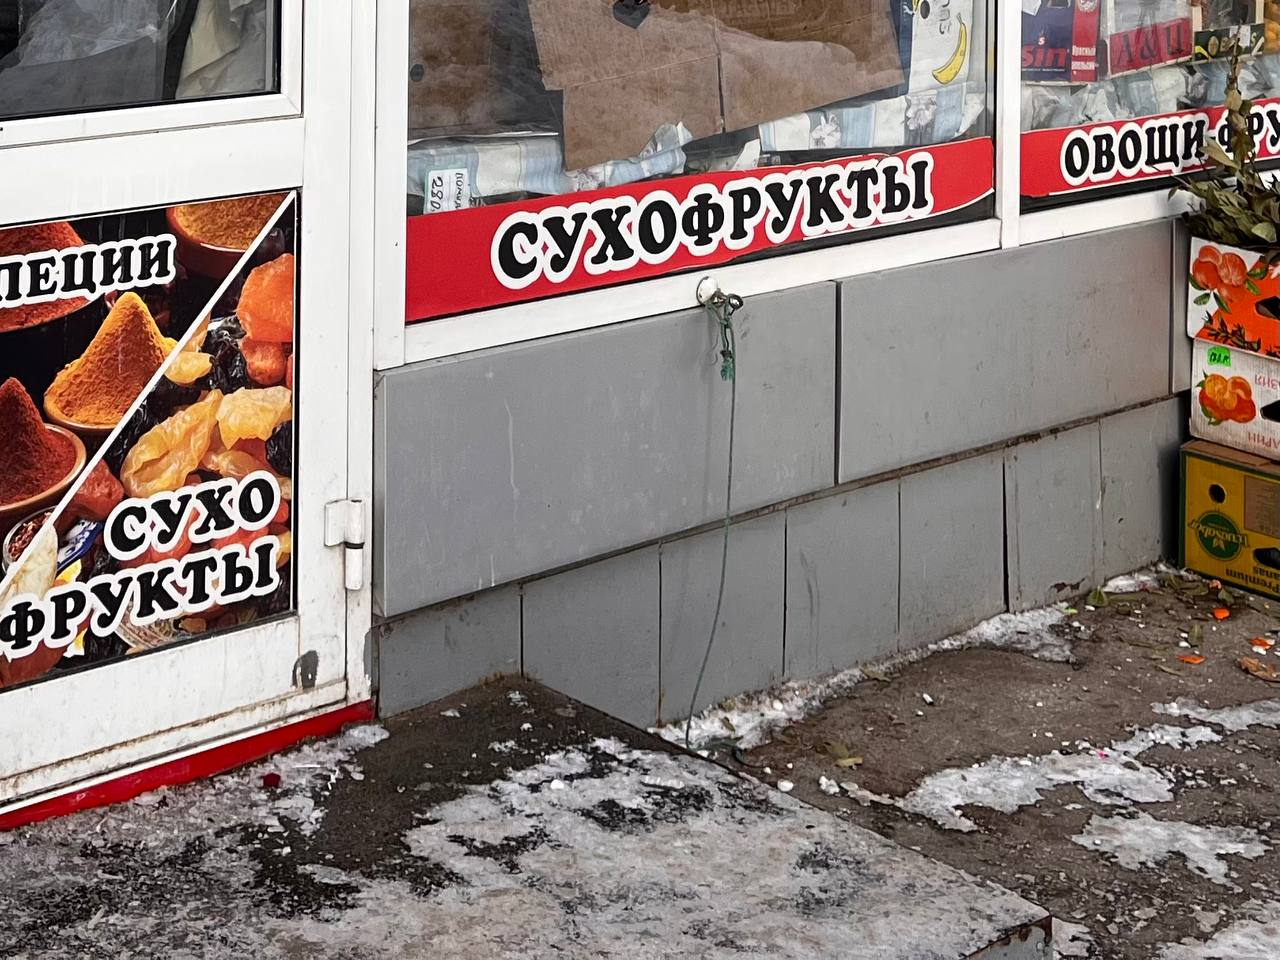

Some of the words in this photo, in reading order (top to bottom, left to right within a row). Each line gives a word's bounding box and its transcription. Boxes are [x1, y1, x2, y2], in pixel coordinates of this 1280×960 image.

[1064, 119, 1207, 178] ОВОЩИ
[497, 159, 929, 279] СУХОФРУКТЫ
[1254, 374, 1280, 390] ЗИЯ
[110, 477, 276, 556] СУХО
